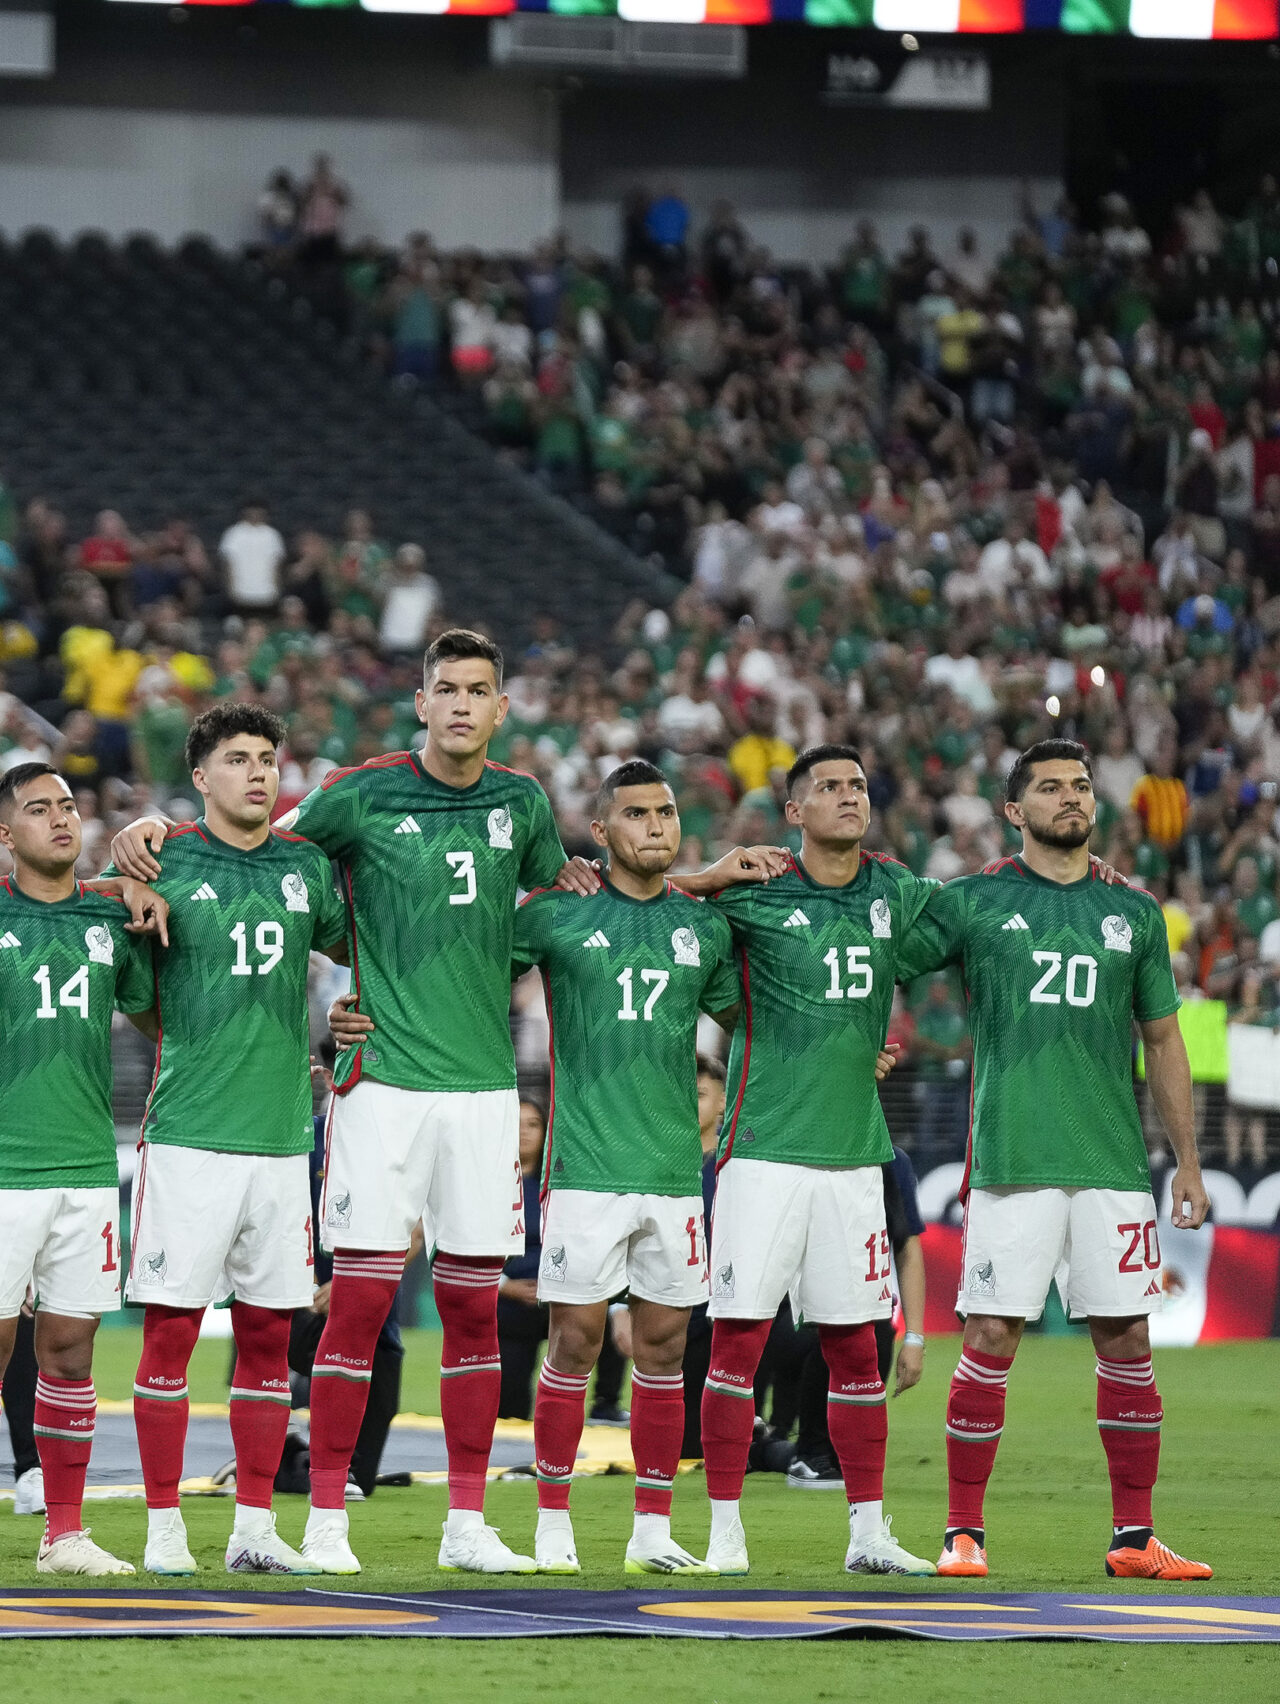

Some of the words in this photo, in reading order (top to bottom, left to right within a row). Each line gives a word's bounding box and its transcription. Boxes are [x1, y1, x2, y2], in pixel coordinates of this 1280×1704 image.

[445, 851, 478, 905] 3
[228, 921, 285, 976] 19
[823, 946, 874, 999] 15
[32, 964, 89, 1019] 14
[616, 967, 669, 1022] 17
[1029, 950, 1098, 1008] 20
[101, 1221, 121, 1272] 1
[686, 1215, 706, 1266] 1
[1117, 1220, 1161, 1274] 20
